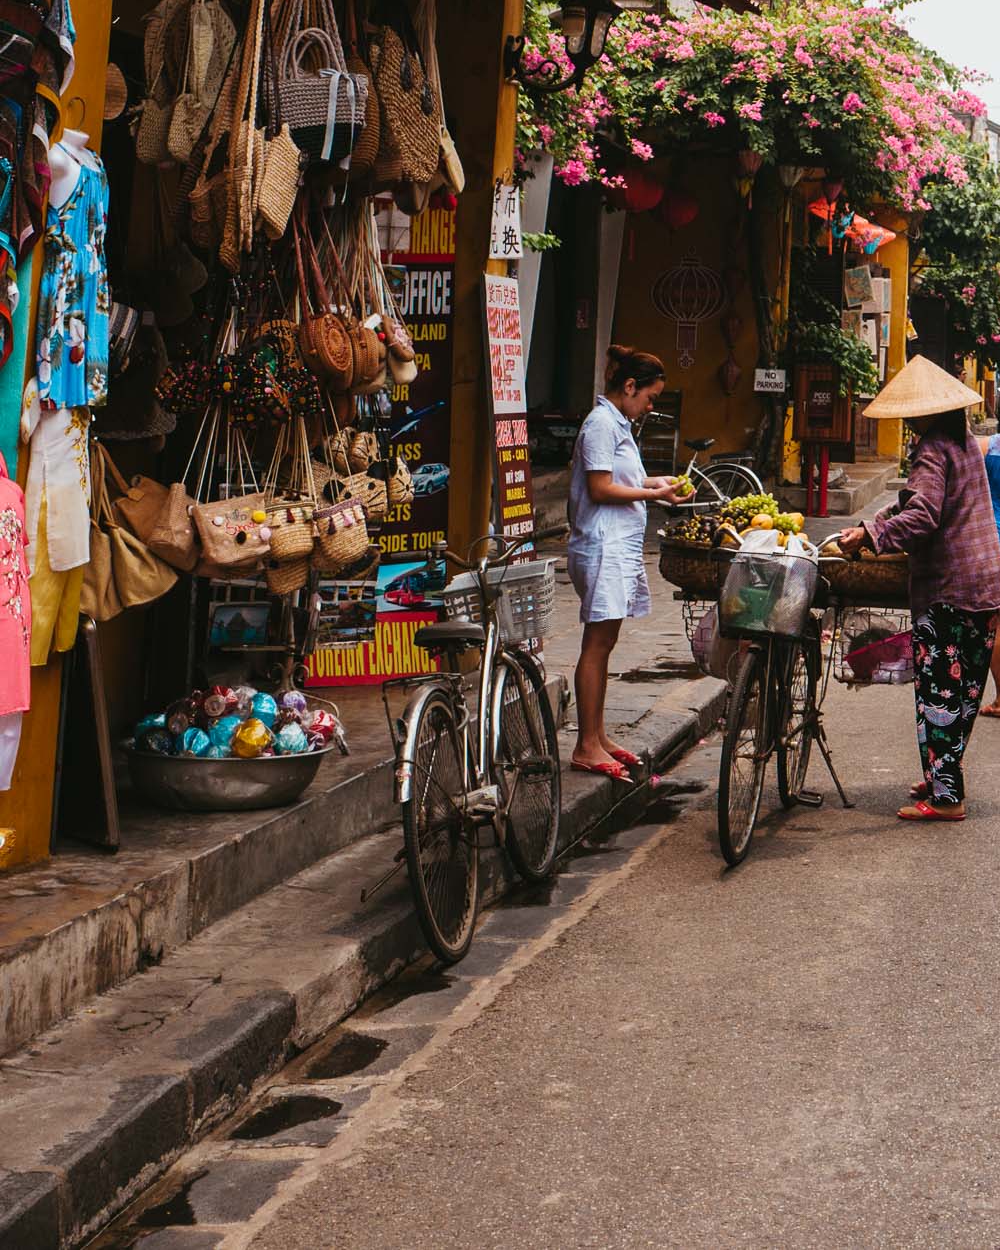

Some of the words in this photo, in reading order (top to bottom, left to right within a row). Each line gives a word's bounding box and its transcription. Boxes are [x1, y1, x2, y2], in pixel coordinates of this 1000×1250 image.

[411, 207, 456, 255] HANGE
[400, 269, 452, 316] OFFICE
[405, 323, 447, 341] SLAND
[764, 372, 777, 380] NO
[756, 381, 784, 390] PARKING
[378, 534, 408, 553] SIDE
